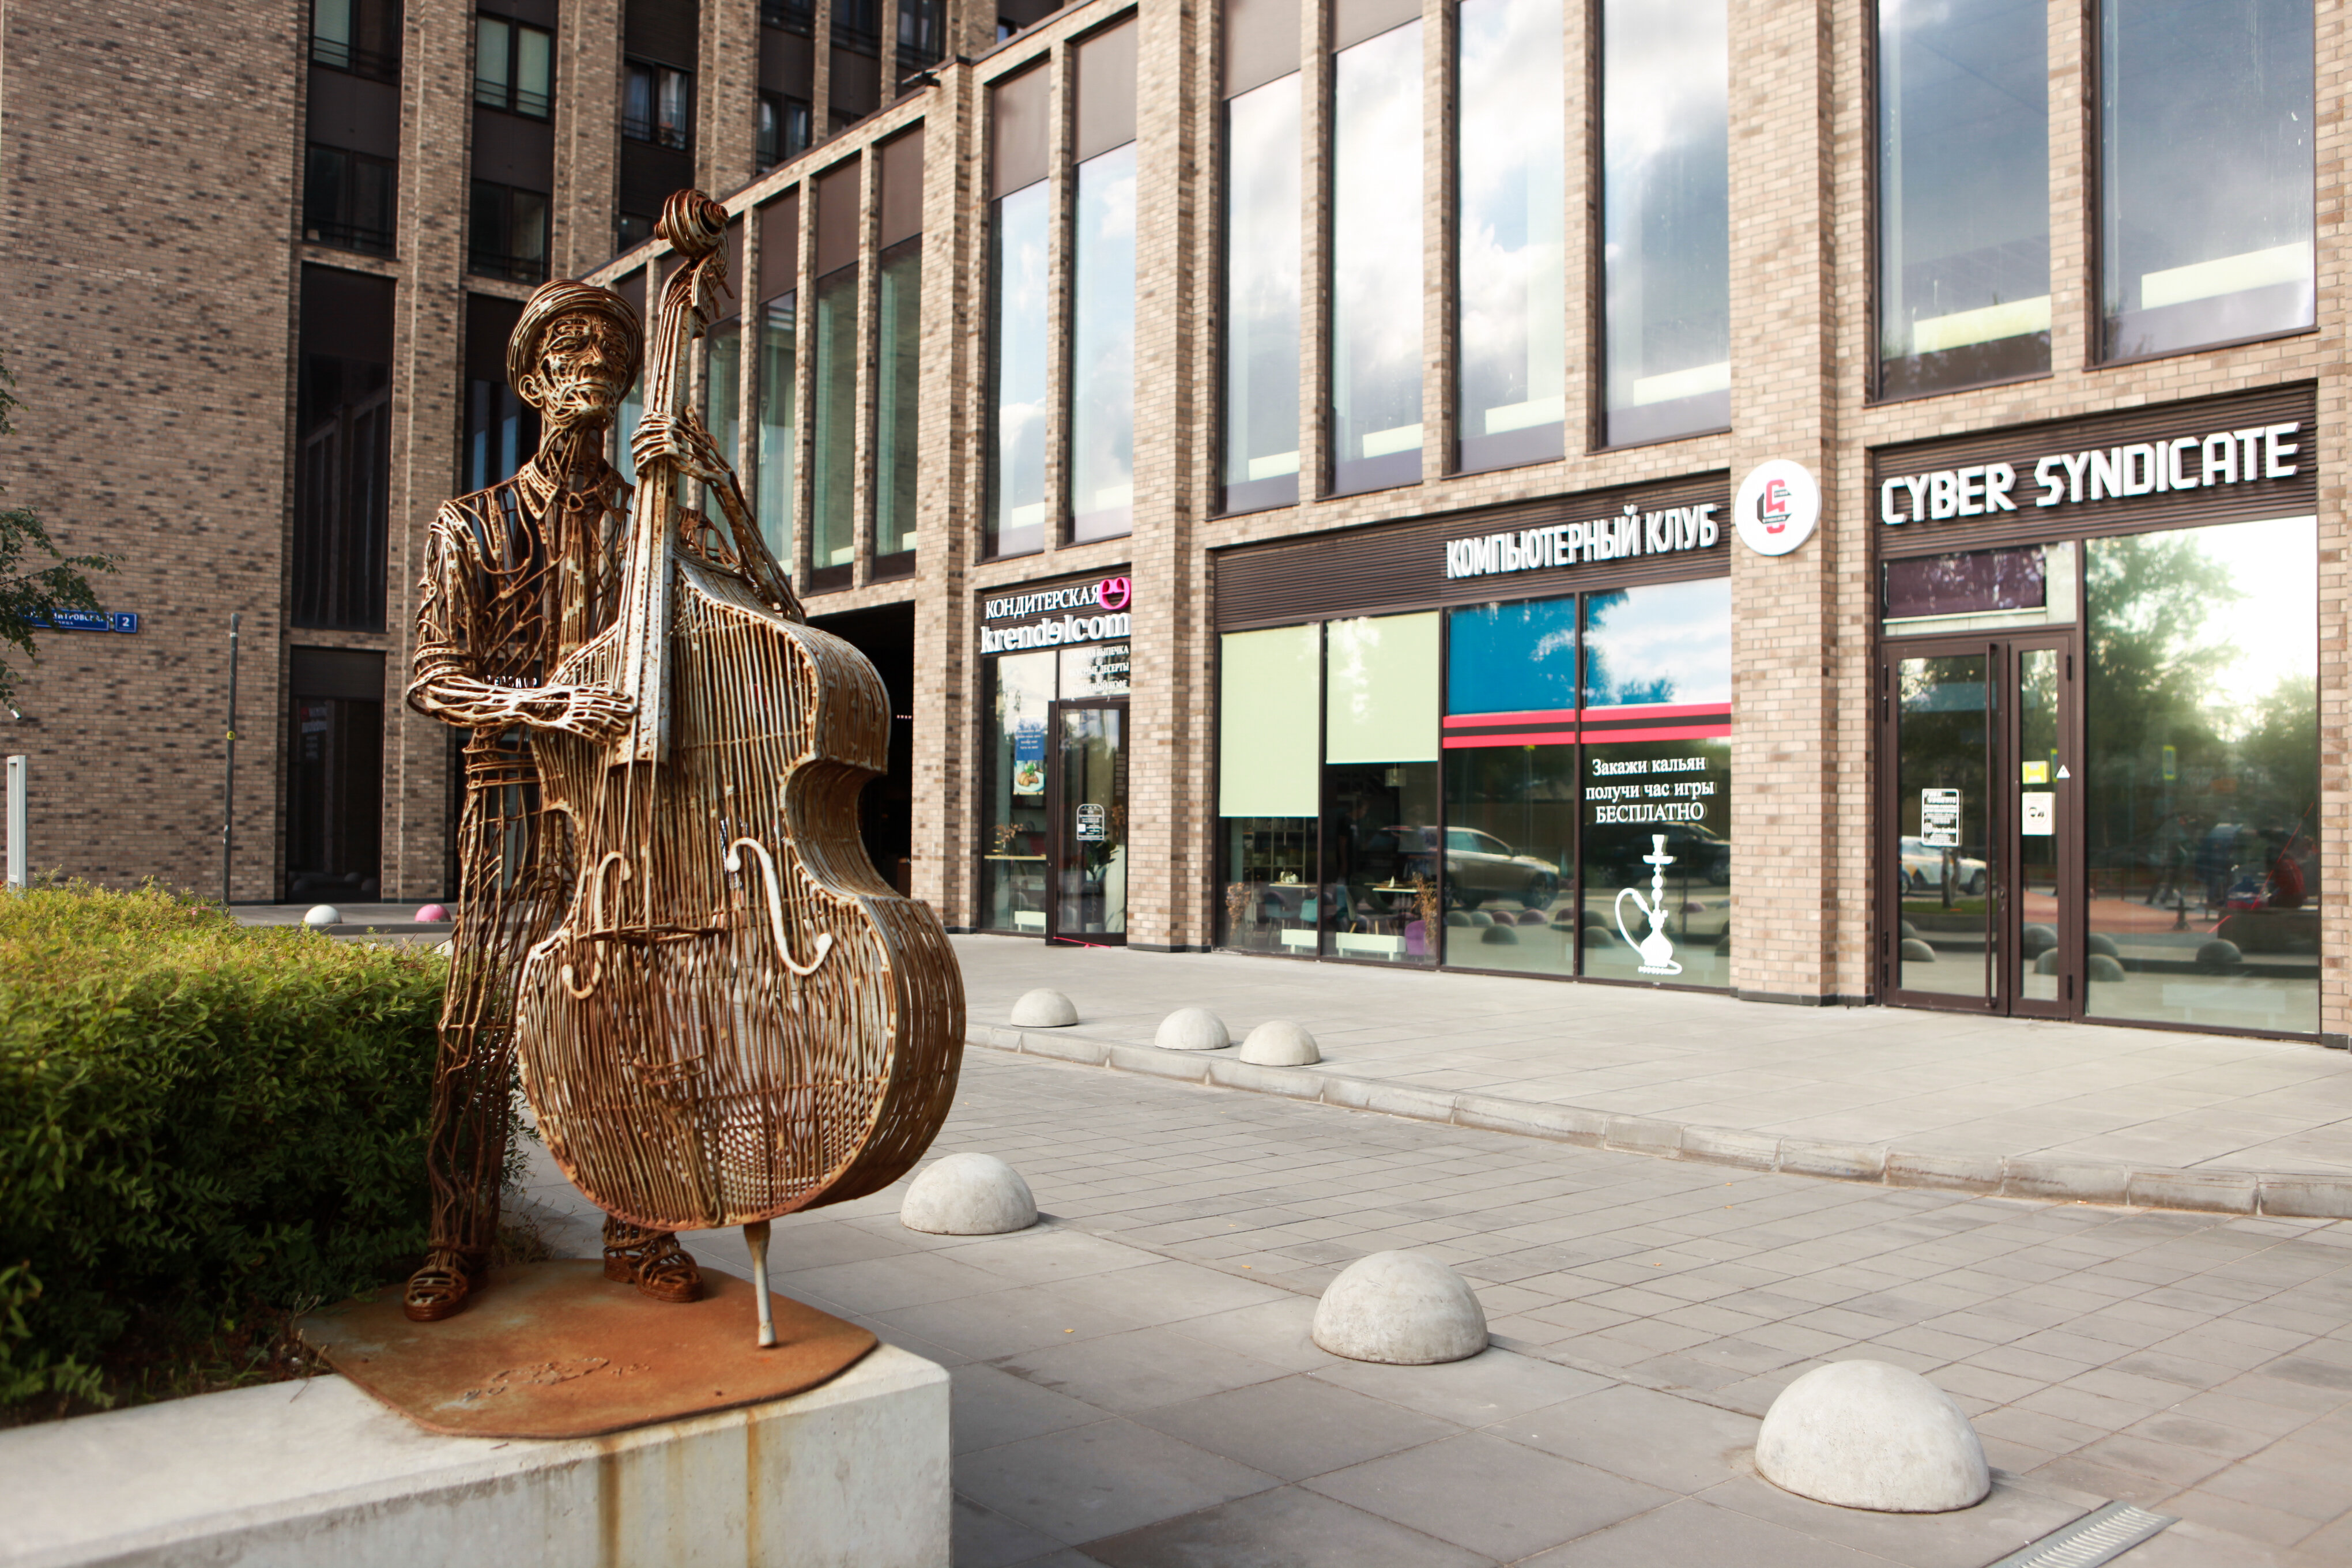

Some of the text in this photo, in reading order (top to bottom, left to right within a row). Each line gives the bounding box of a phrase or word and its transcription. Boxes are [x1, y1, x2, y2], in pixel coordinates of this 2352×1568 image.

[1882, 422, 2300, 525] CYBER SYNDICATE
[1447, 503, 1718, 578] КОМПЬЮТЕРНЫЙ КЛУБ
[985, 584, 1100, 619] КОНДИТЕРСКАЯ
[122, 617, 130, 627] 2
[1096, 646, 1129, 657] ВЫПЕЧКА
[1098, 662, 1129, 674] ДЕСЕРТЫ
[1109, 680, 1127, 689] КОФЕ
[1592, 757, 1706, 776] Закажи кальян
[1585, 781, 1714, 803] получи час игры
[1596, 802, 1704, 823] БЕСПЛАТНО
